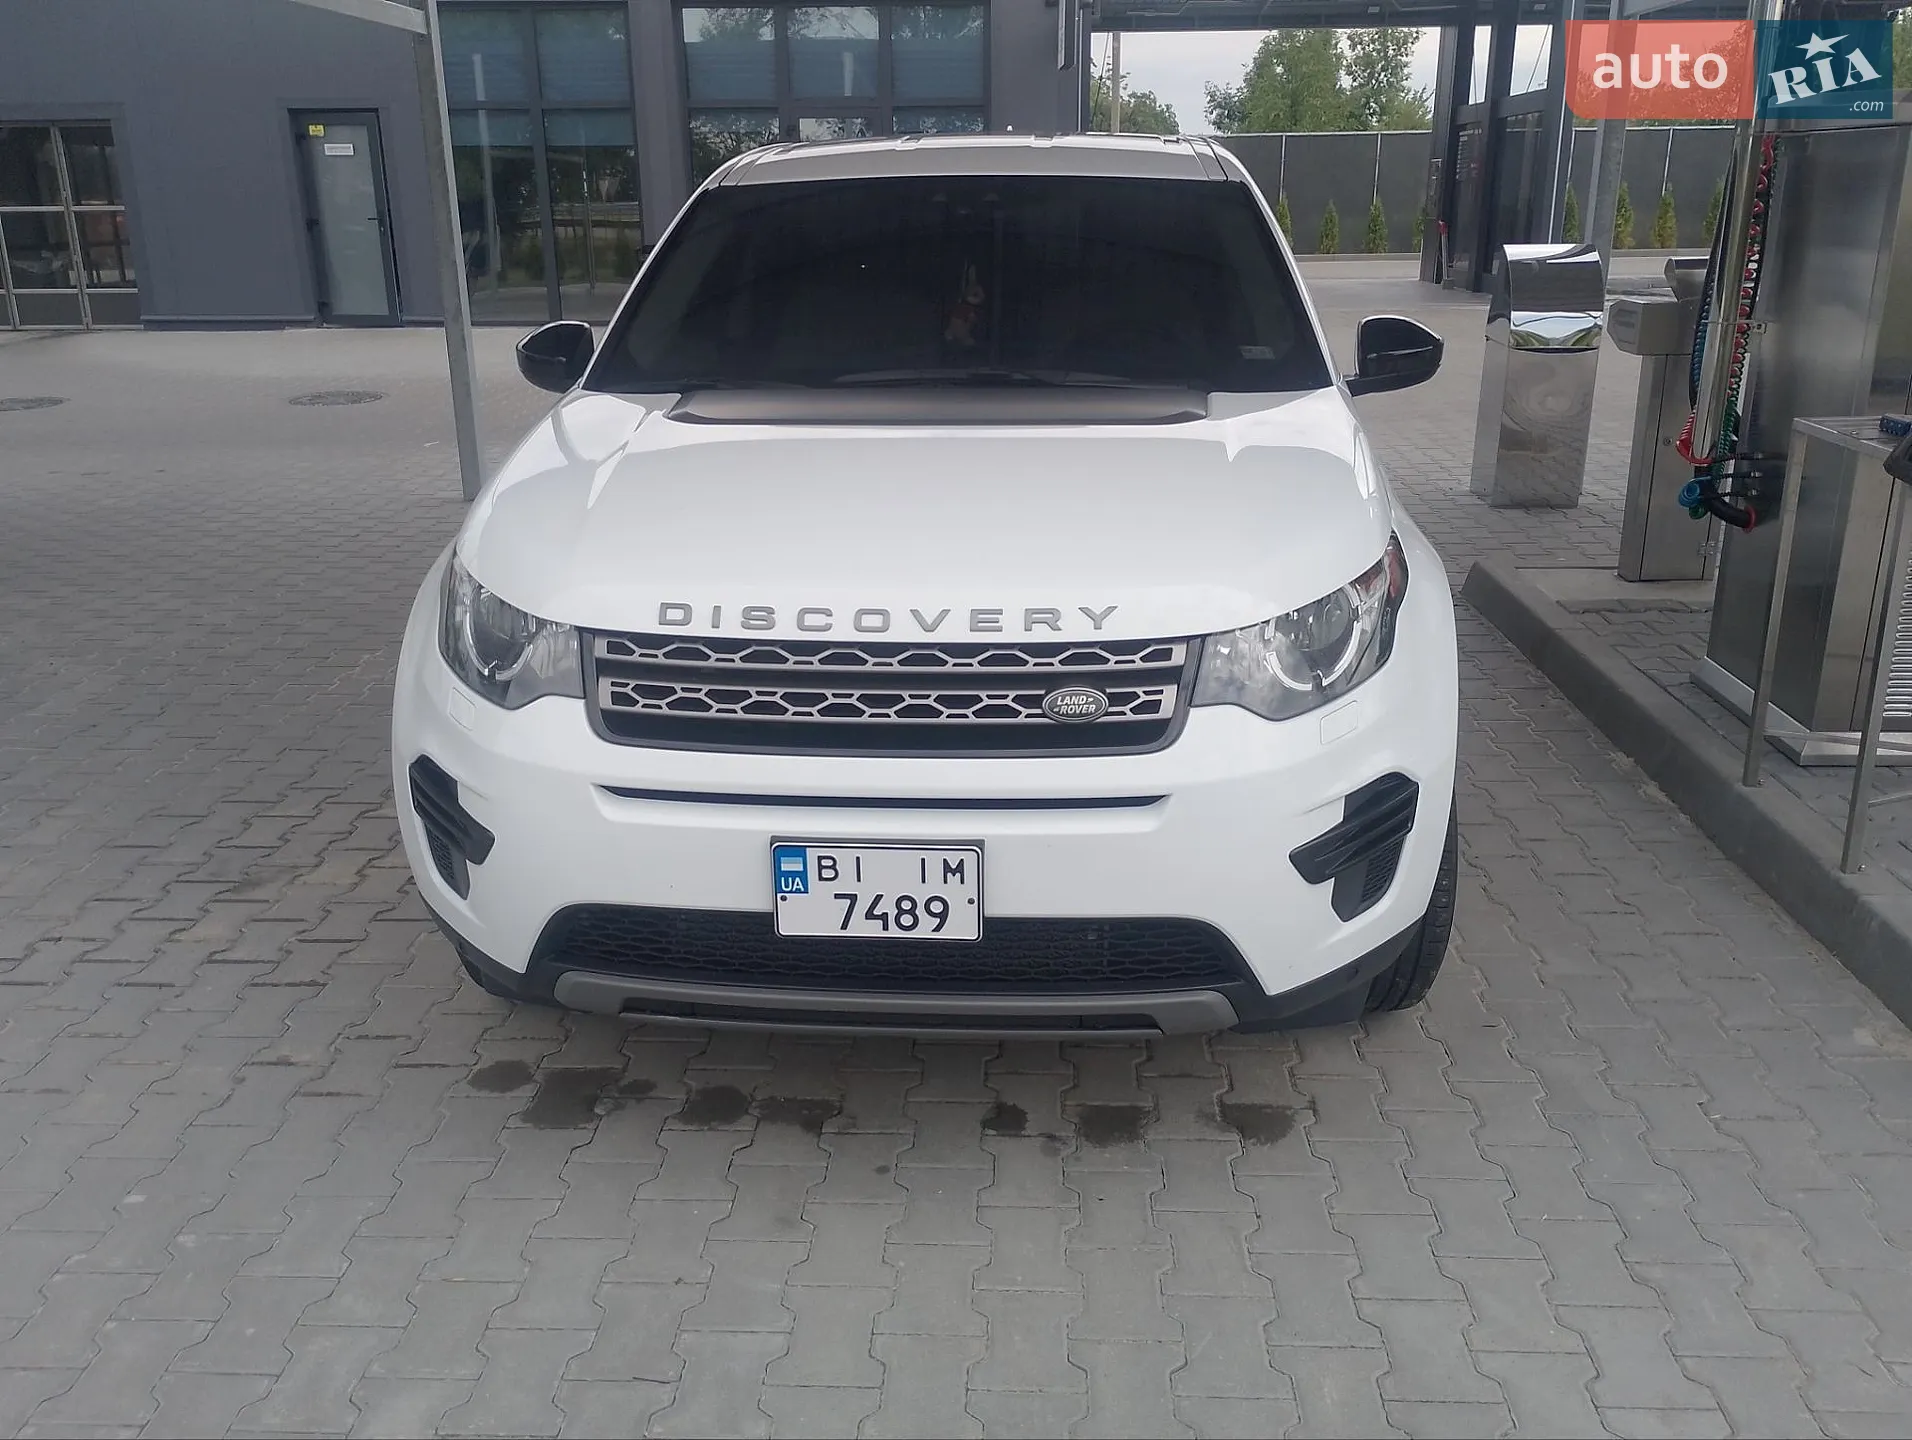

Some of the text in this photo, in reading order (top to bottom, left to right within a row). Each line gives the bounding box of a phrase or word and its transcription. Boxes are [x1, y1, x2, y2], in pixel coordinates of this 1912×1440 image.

[658, 602, 1119, 632] DISCOVERY
[1056, 695, 1087, 706] LAND
[1059, 704, 1096, 715] ROVER
[817, 855, 965, 885] BI IM
[781, 877, 804, 892] UA
[834, 892, 950, 933] 7489
